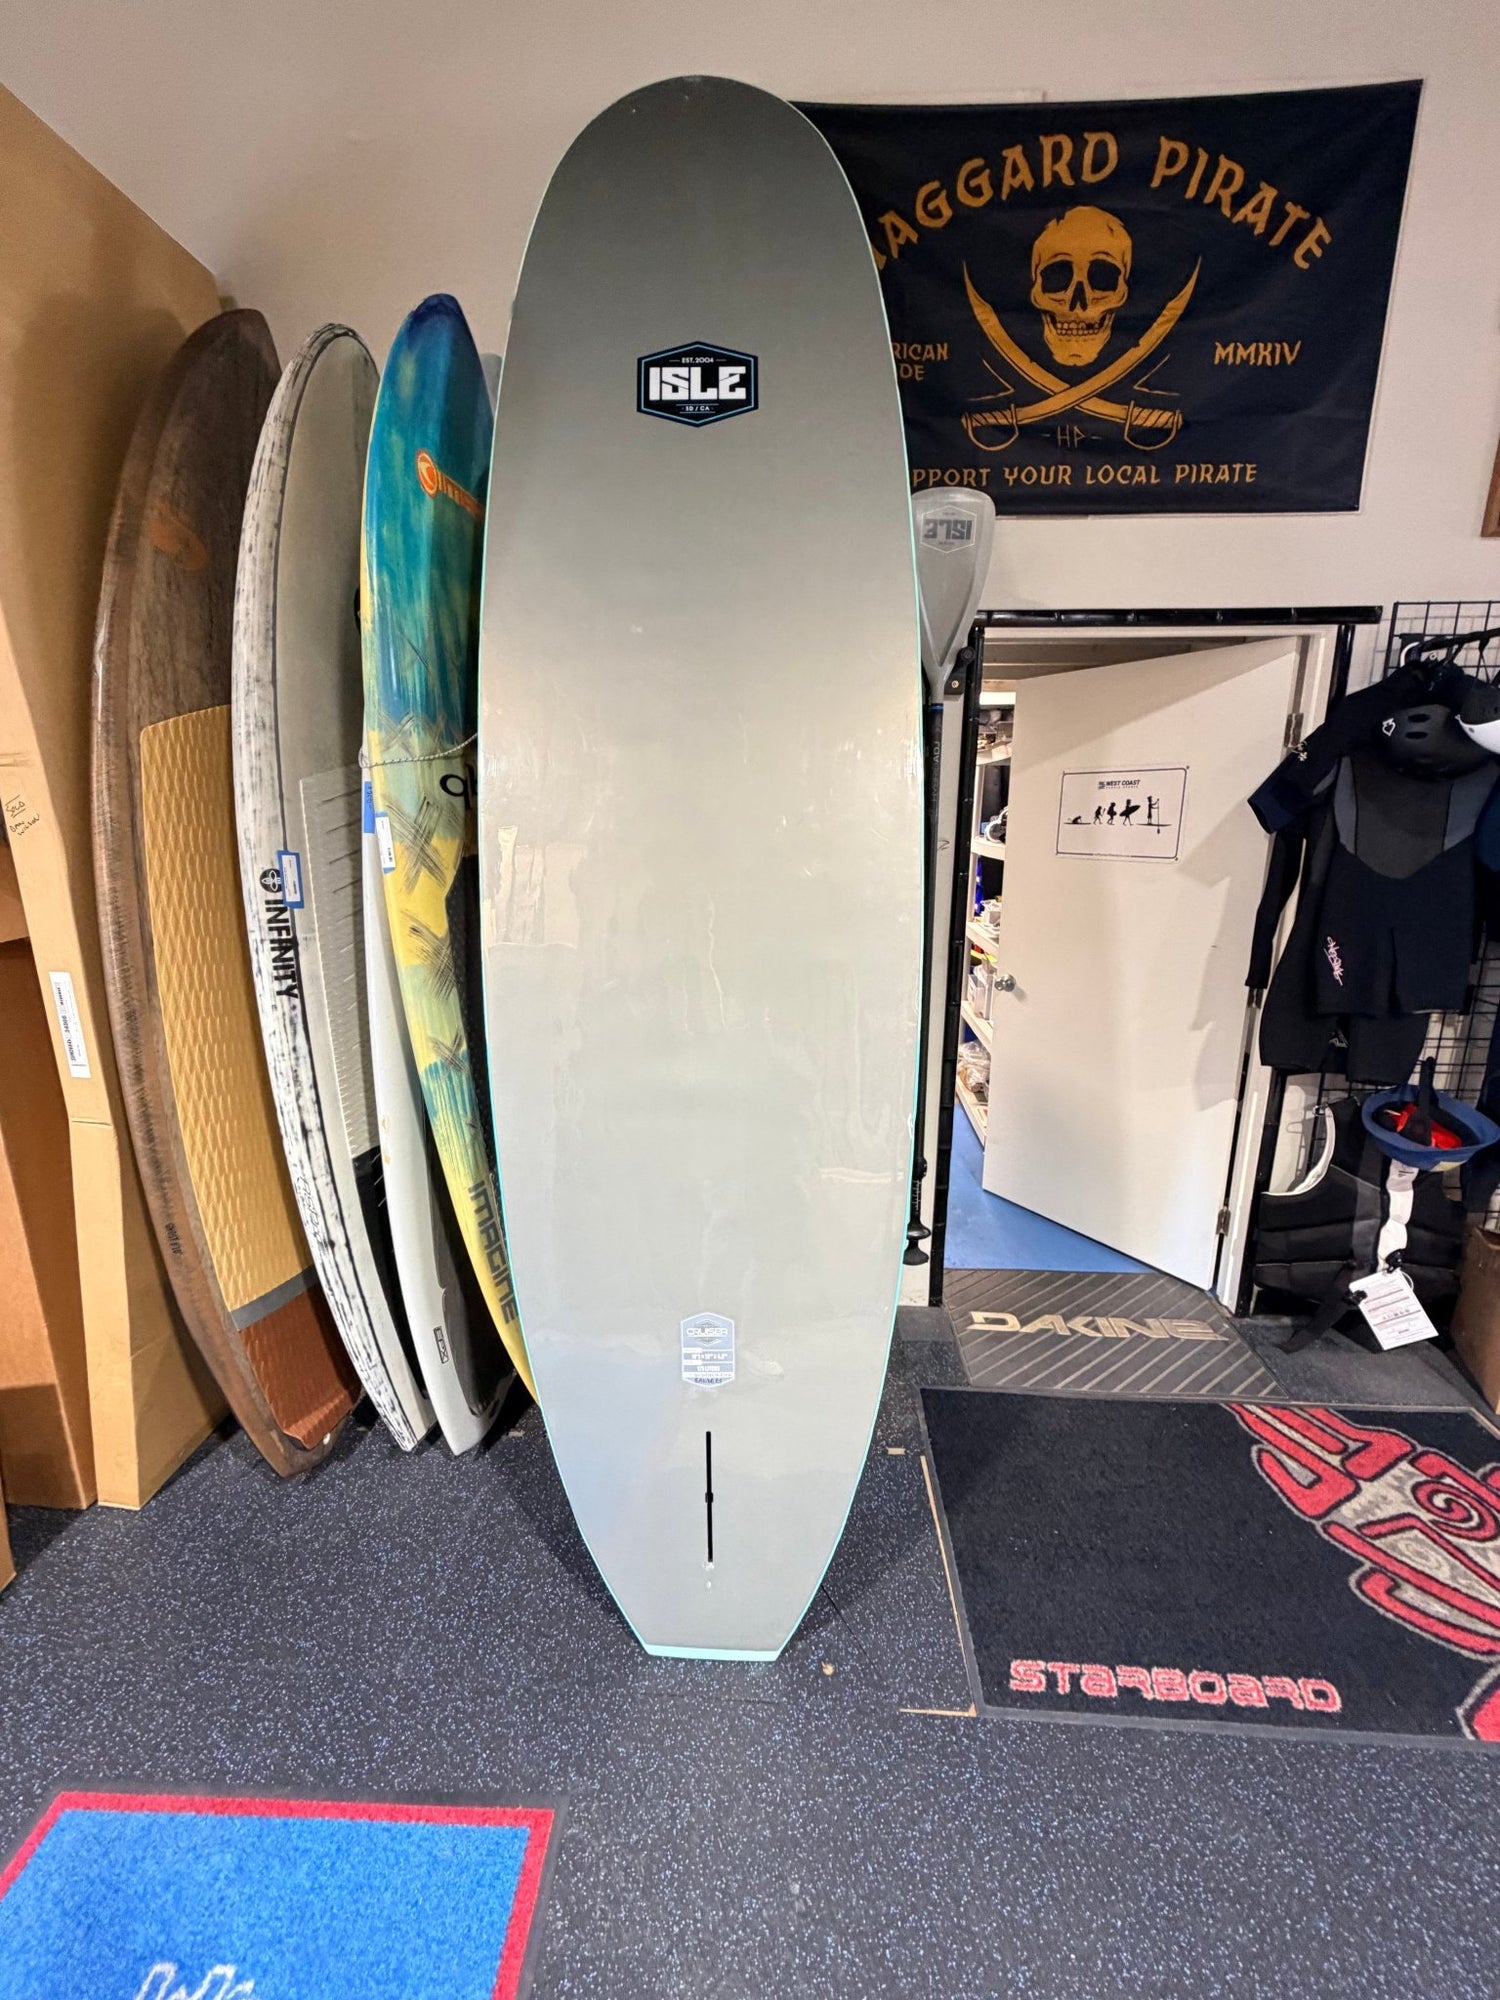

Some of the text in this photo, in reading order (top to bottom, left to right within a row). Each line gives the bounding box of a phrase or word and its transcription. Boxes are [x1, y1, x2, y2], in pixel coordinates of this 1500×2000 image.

[871, 131, 1332, 270] AGGARD PIRATE
[1213, 340, 1301, 366] MMXIV
[649, 366, 746, 400] ISLE
[913, 463, 1257, 487] PPORT YOUR LOCAL PIRATE
[924, 519, 972, 540] ISLE
[265, 899, 299, 999] INFINITY
[468, 1180, 519, 1324] IMAGINE
[966, 1311, 1229, 1341] DAKINE
